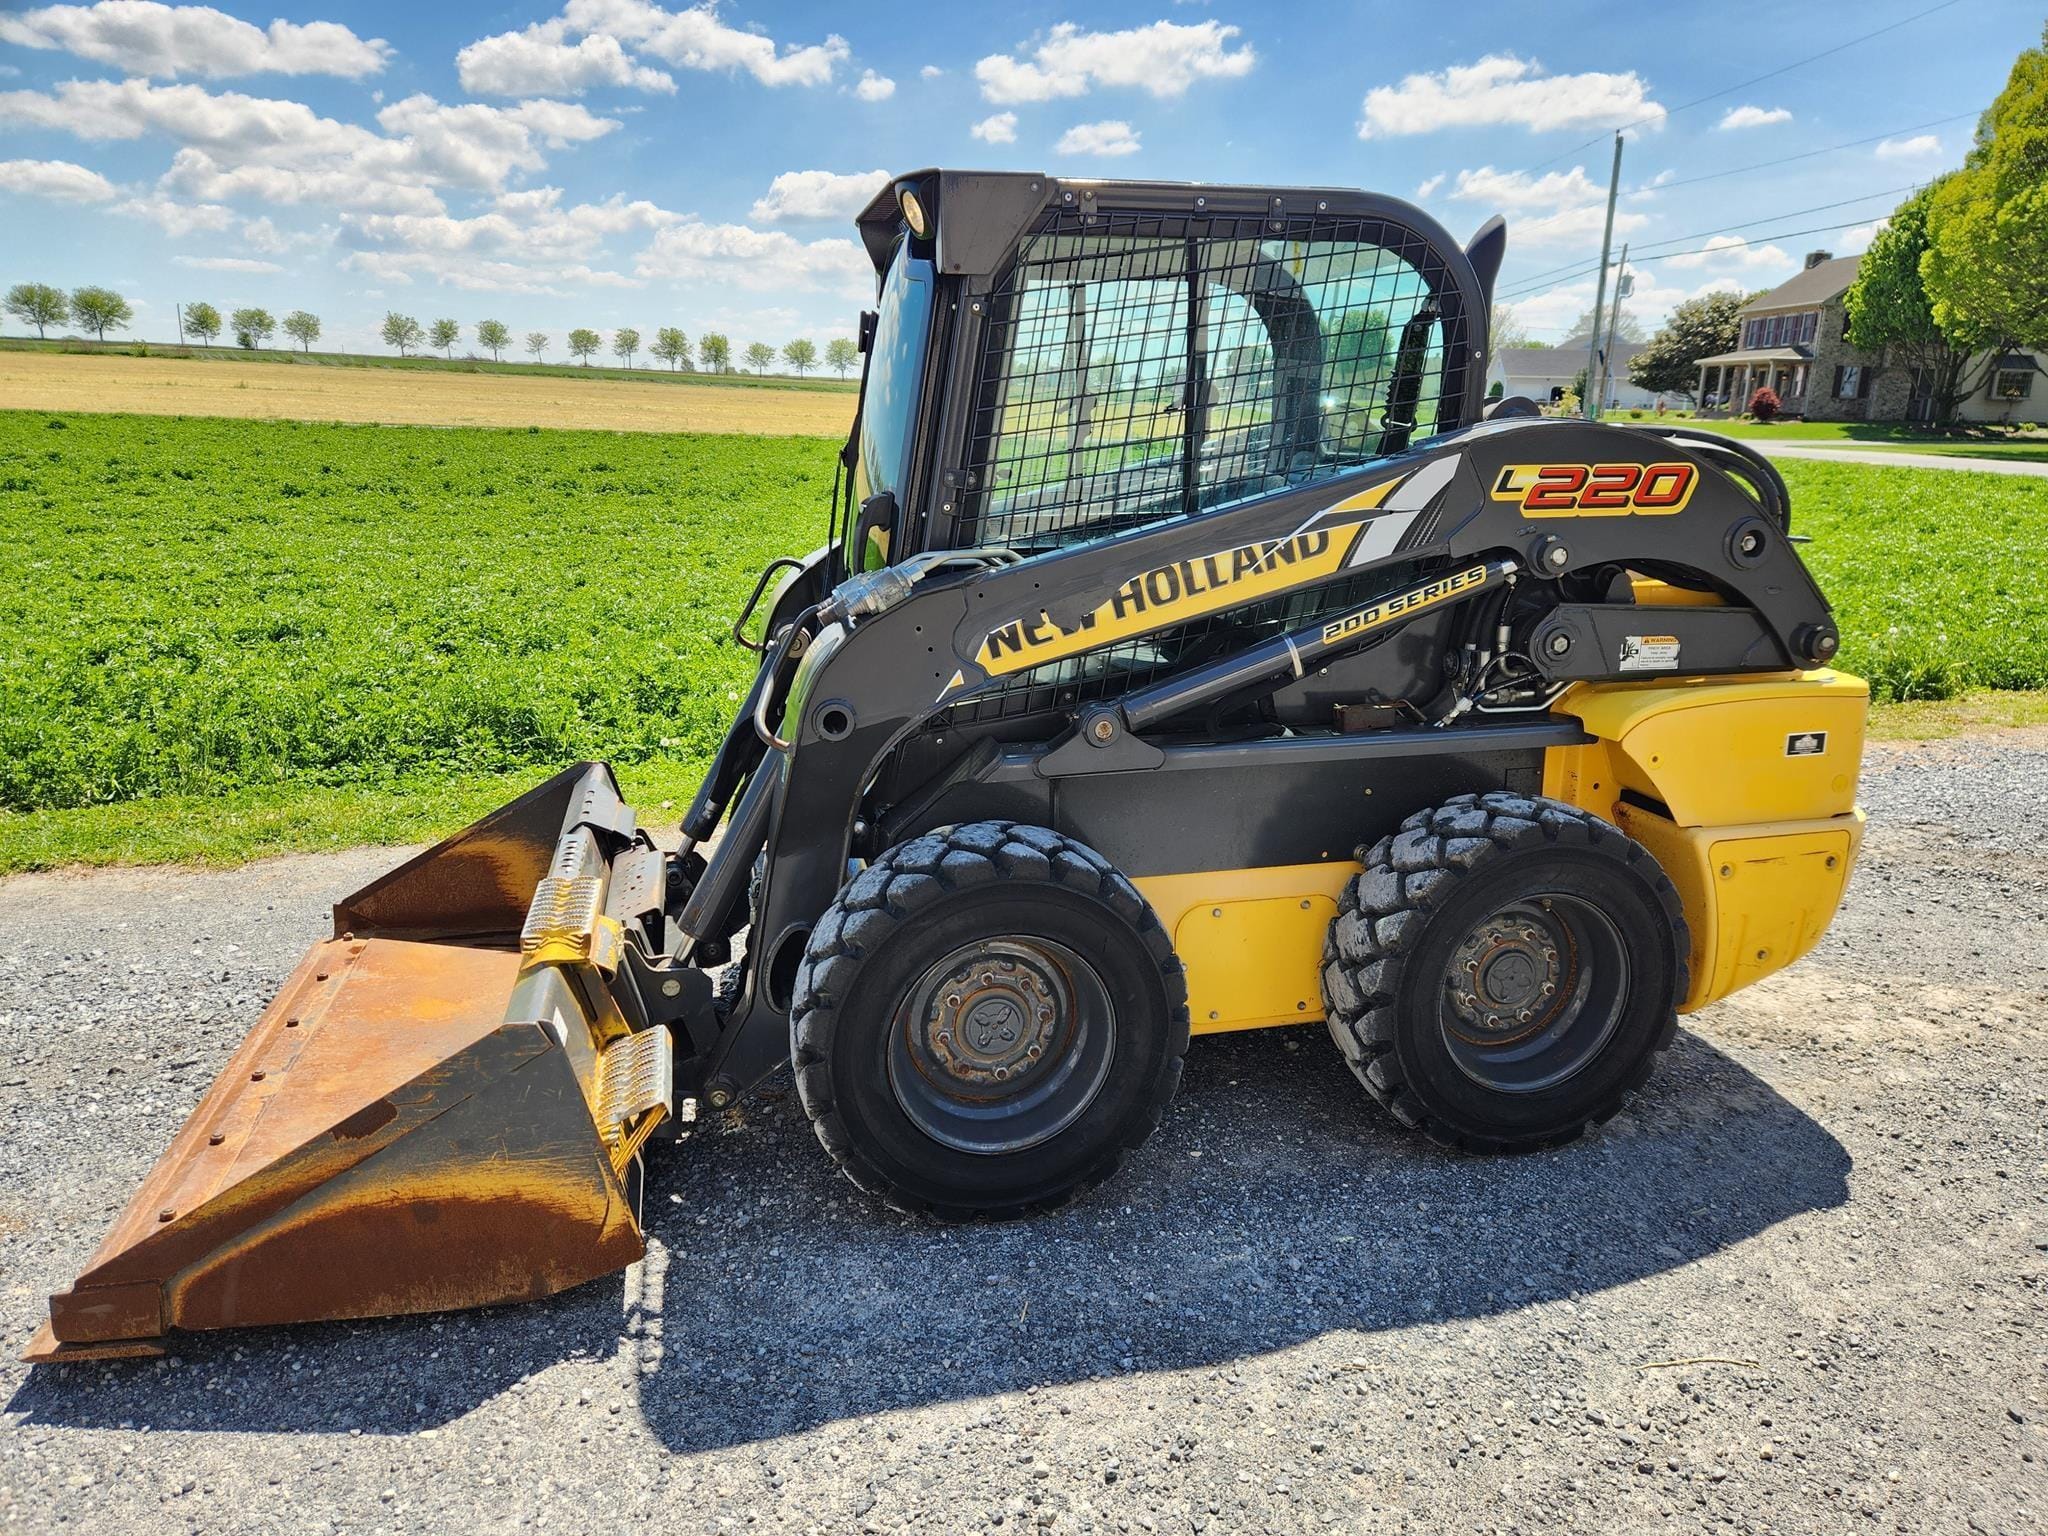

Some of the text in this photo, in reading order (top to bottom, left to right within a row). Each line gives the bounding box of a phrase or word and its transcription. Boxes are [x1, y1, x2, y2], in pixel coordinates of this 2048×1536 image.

[1495, 464, 1694, 511] L220
[1112, 529, 1331, 619] HOLLAND
[1324, 567, 1484, 640] 200 SERIES
